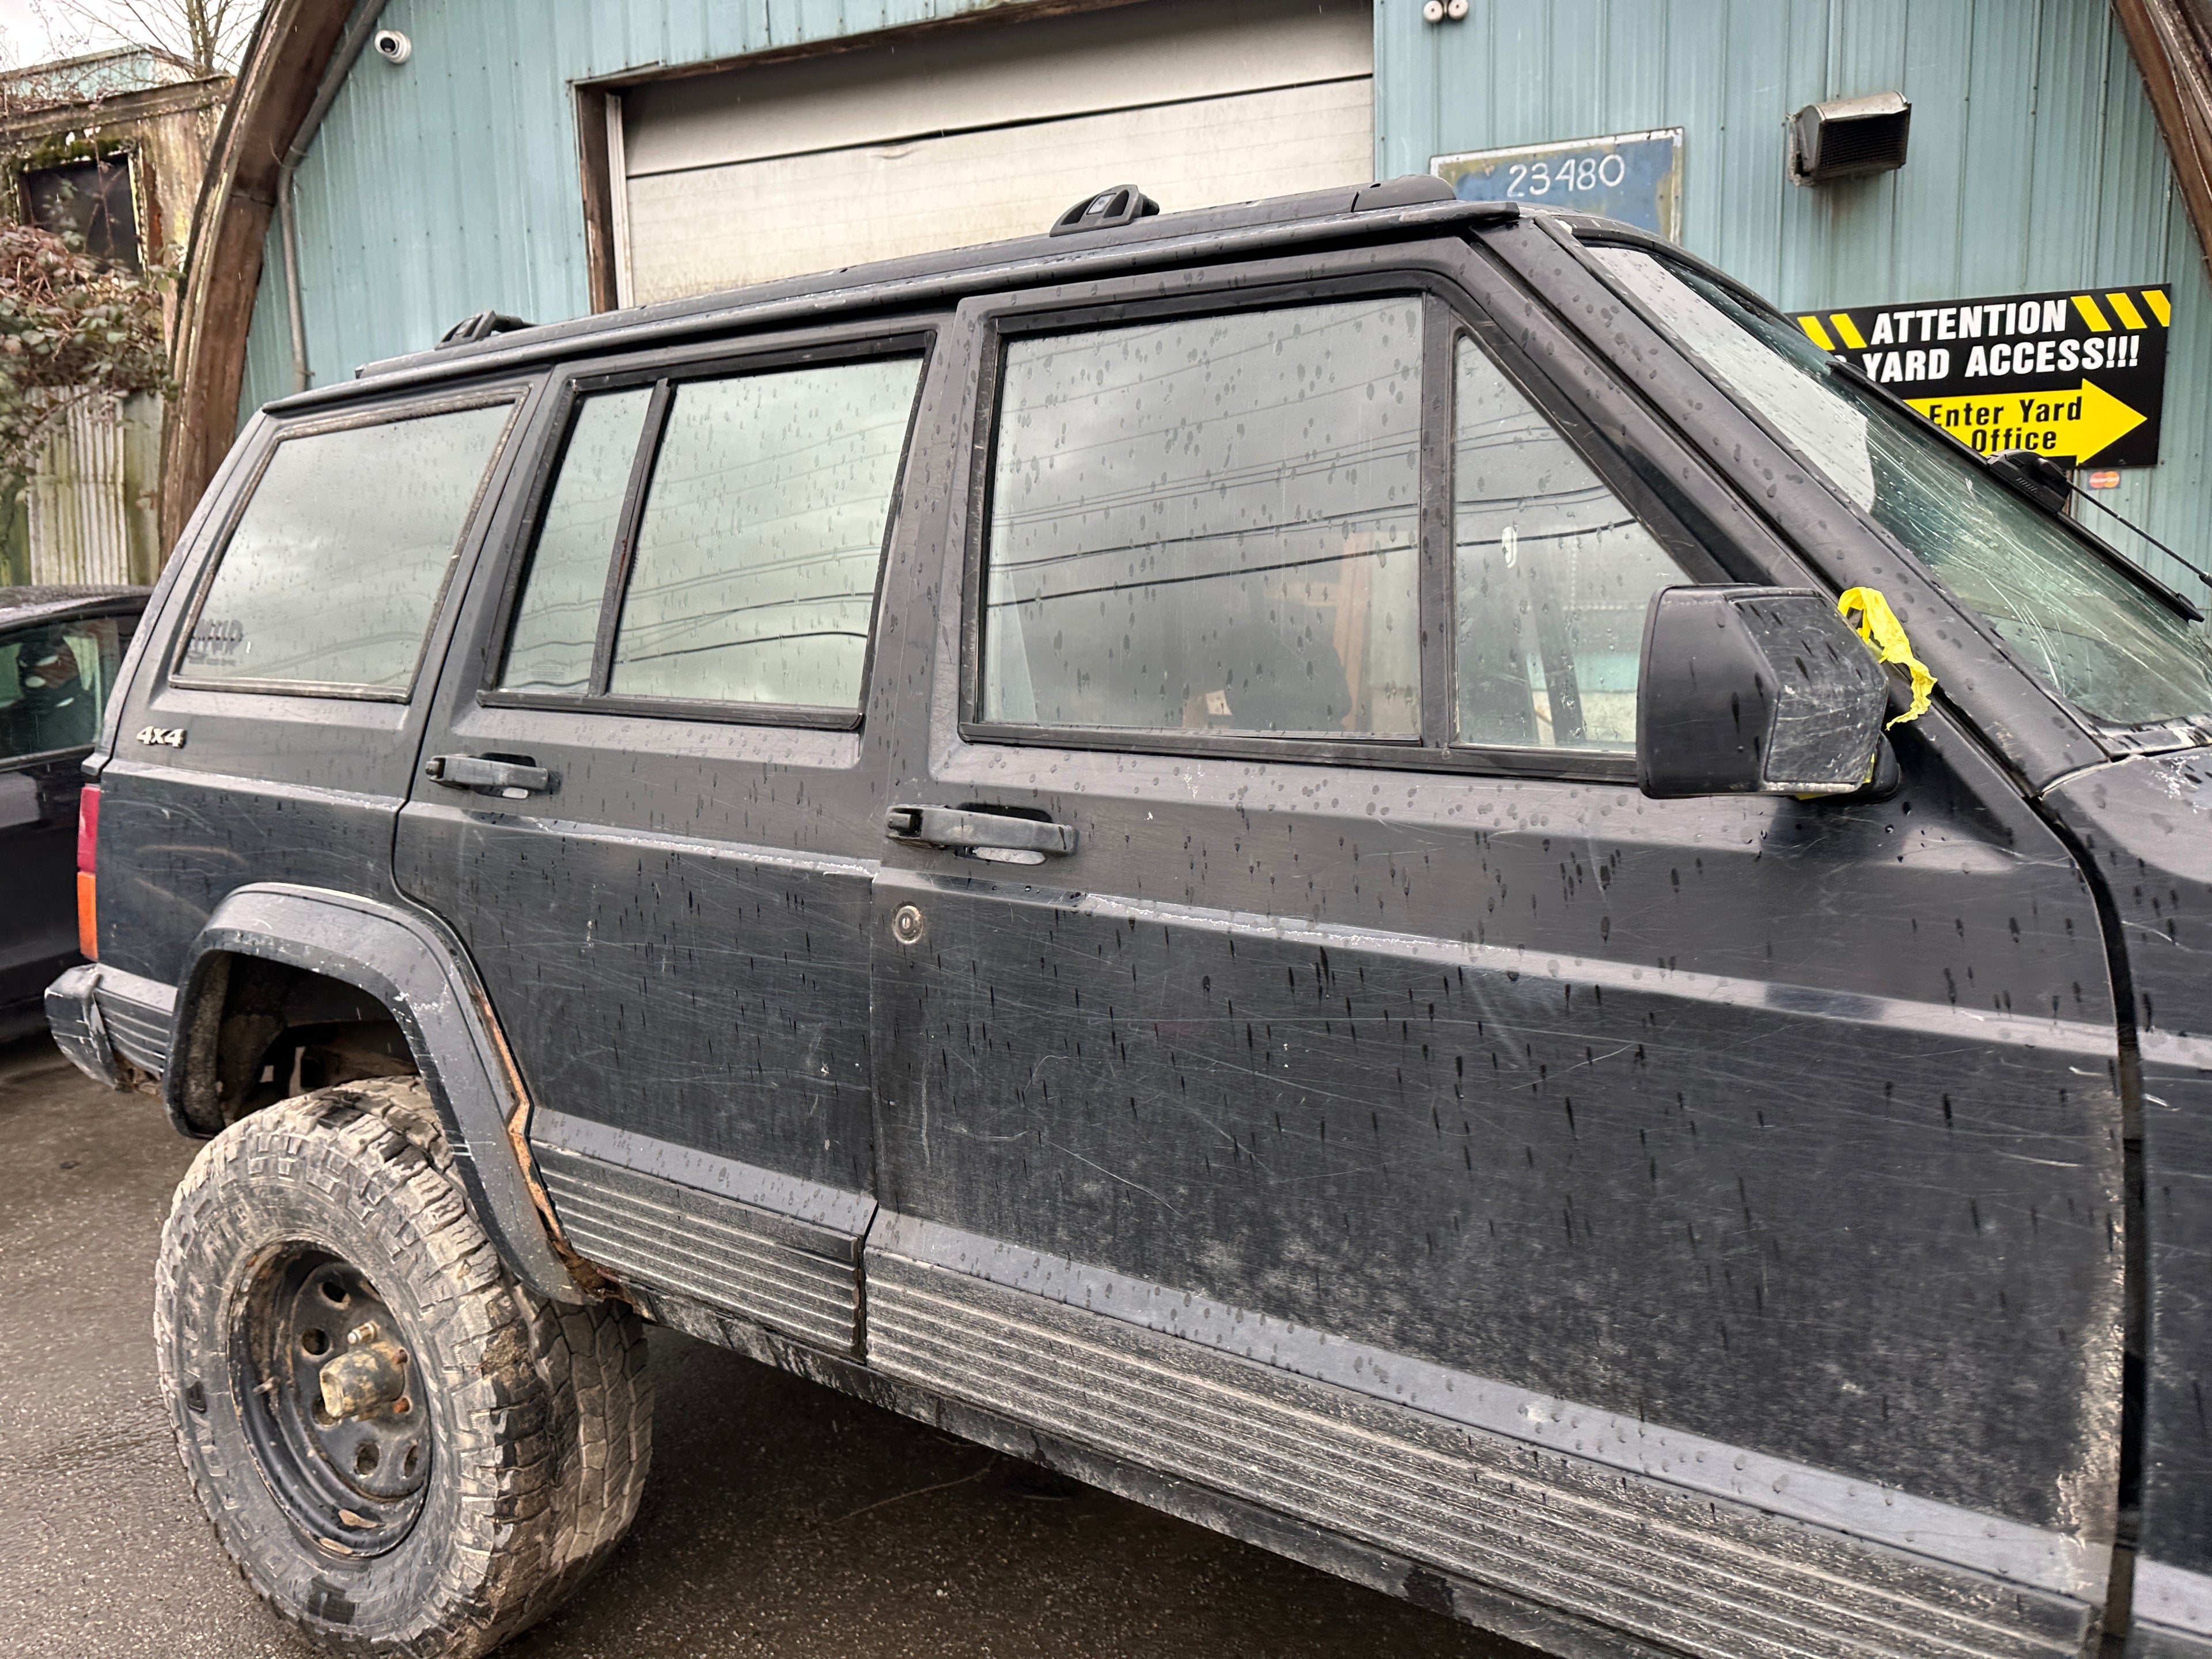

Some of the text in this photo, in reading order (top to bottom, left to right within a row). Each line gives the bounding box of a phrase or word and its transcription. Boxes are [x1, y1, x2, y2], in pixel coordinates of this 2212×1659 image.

[1506, 154, 1625, 198] 23480
[1870, 299, 2067, 346] ATTENTION
[1862, 335, 2140, 383] YARD ACCESS!!!
[1929, 396, 2082, 427] Enter Yard
[1971, 427, 2057, 453] Office
